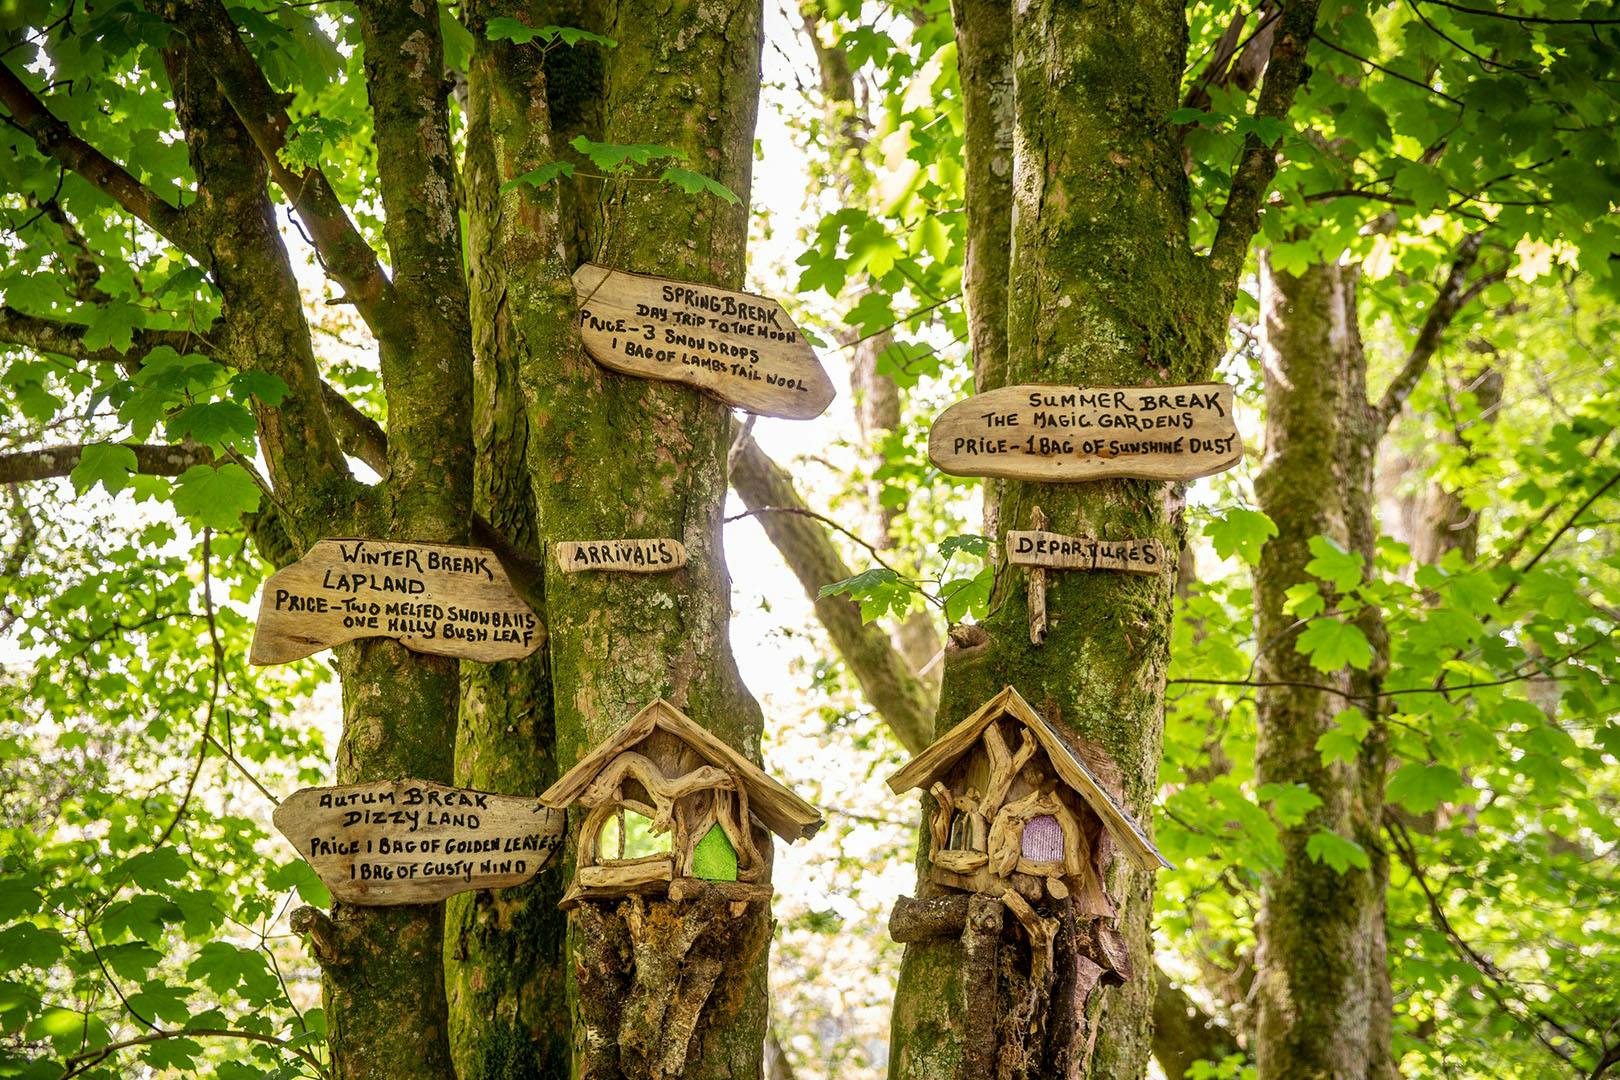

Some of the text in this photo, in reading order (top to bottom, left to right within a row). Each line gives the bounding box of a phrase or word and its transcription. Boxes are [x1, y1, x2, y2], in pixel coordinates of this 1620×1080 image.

[663, 285, 782, 331] SPRING BREAK
[636, 304, 668, 321] DAY
[672, 309, 705, 327] TRIP
[731, 321, 755, 336] THE
[757, 326, 796, 343] MOON
[642, 324, 656, 340] 3
[625, 342, 653, 359] BAG
[655, 350, 676, 362] OF
[682, 353, 727, 372] LAMBS
[730, 364, 761, 381] TAIL
[766, 373, 808, 393] WOOL
[1029, 391, 1225, 417] SUMMER BREAK
[981, 411, 1194, 432] THE MAGIC GARDENS
[1025, 435, 1036, 454] 1
[1039, 437, 1073, 454] BAG
[1083, 439, 1105, 454] OF
[1109, 437, 1184, 455] SUNSHINE
[1190, 433, 1235, 454] DUST
[340, 542, 494, 582] WINTER BREAK
[1015, 537, 1157, 564] DEPARTURES
[385, 602, 444, 620] MELTED
[343, 616, 378, 629] ONE
[443, 623, 487, 642] BUSH
[494, 629, 533, 648] LEAF
[319, 787, 488, 810] AUTUM BREAK
[343, 809, 480, 832] DIZZY LAND
[310, 837, 359, 857] PRICE
[378, 837, 417, 855] BAG
[420, 839, 440, 853] OF
[445, 838, 500, 855] GOLDEN
[360, 863, 394, 881] BAG
[397, 865, 418, 880] OF
[423, 860, 474, 883] GUSTY
[480, 859, 527, 874] WIND
